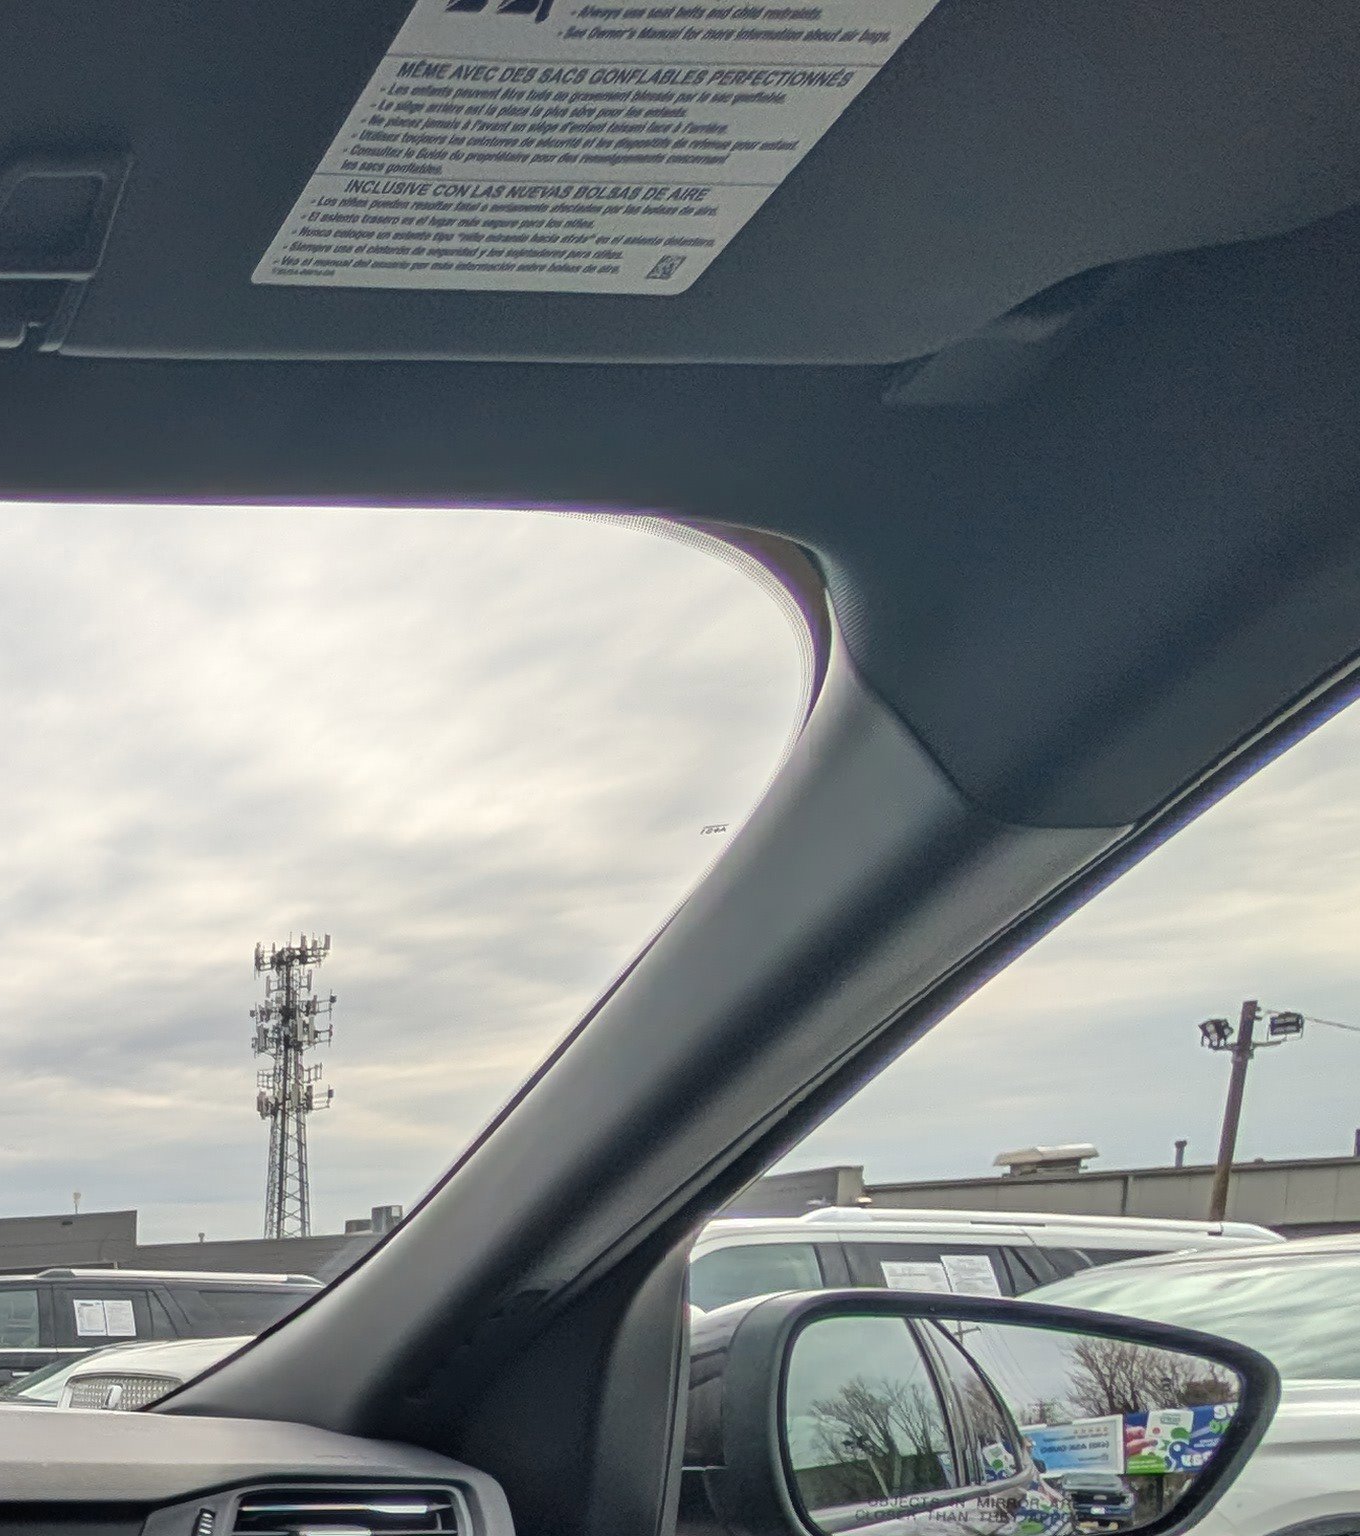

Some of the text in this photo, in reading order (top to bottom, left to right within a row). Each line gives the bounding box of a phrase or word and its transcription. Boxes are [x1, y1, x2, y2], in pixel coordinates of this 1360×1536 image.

[449, 65, 500, 81] AVEC
[497, 67, 539, 83] DES
[536, 67, 590, 84] SACS
[588, 68, 710, 85] GONFLABLES
[344, 180, 713, 202] INCLUSIVE CON LAS NUEVAS BOLSAS DE AIRE
